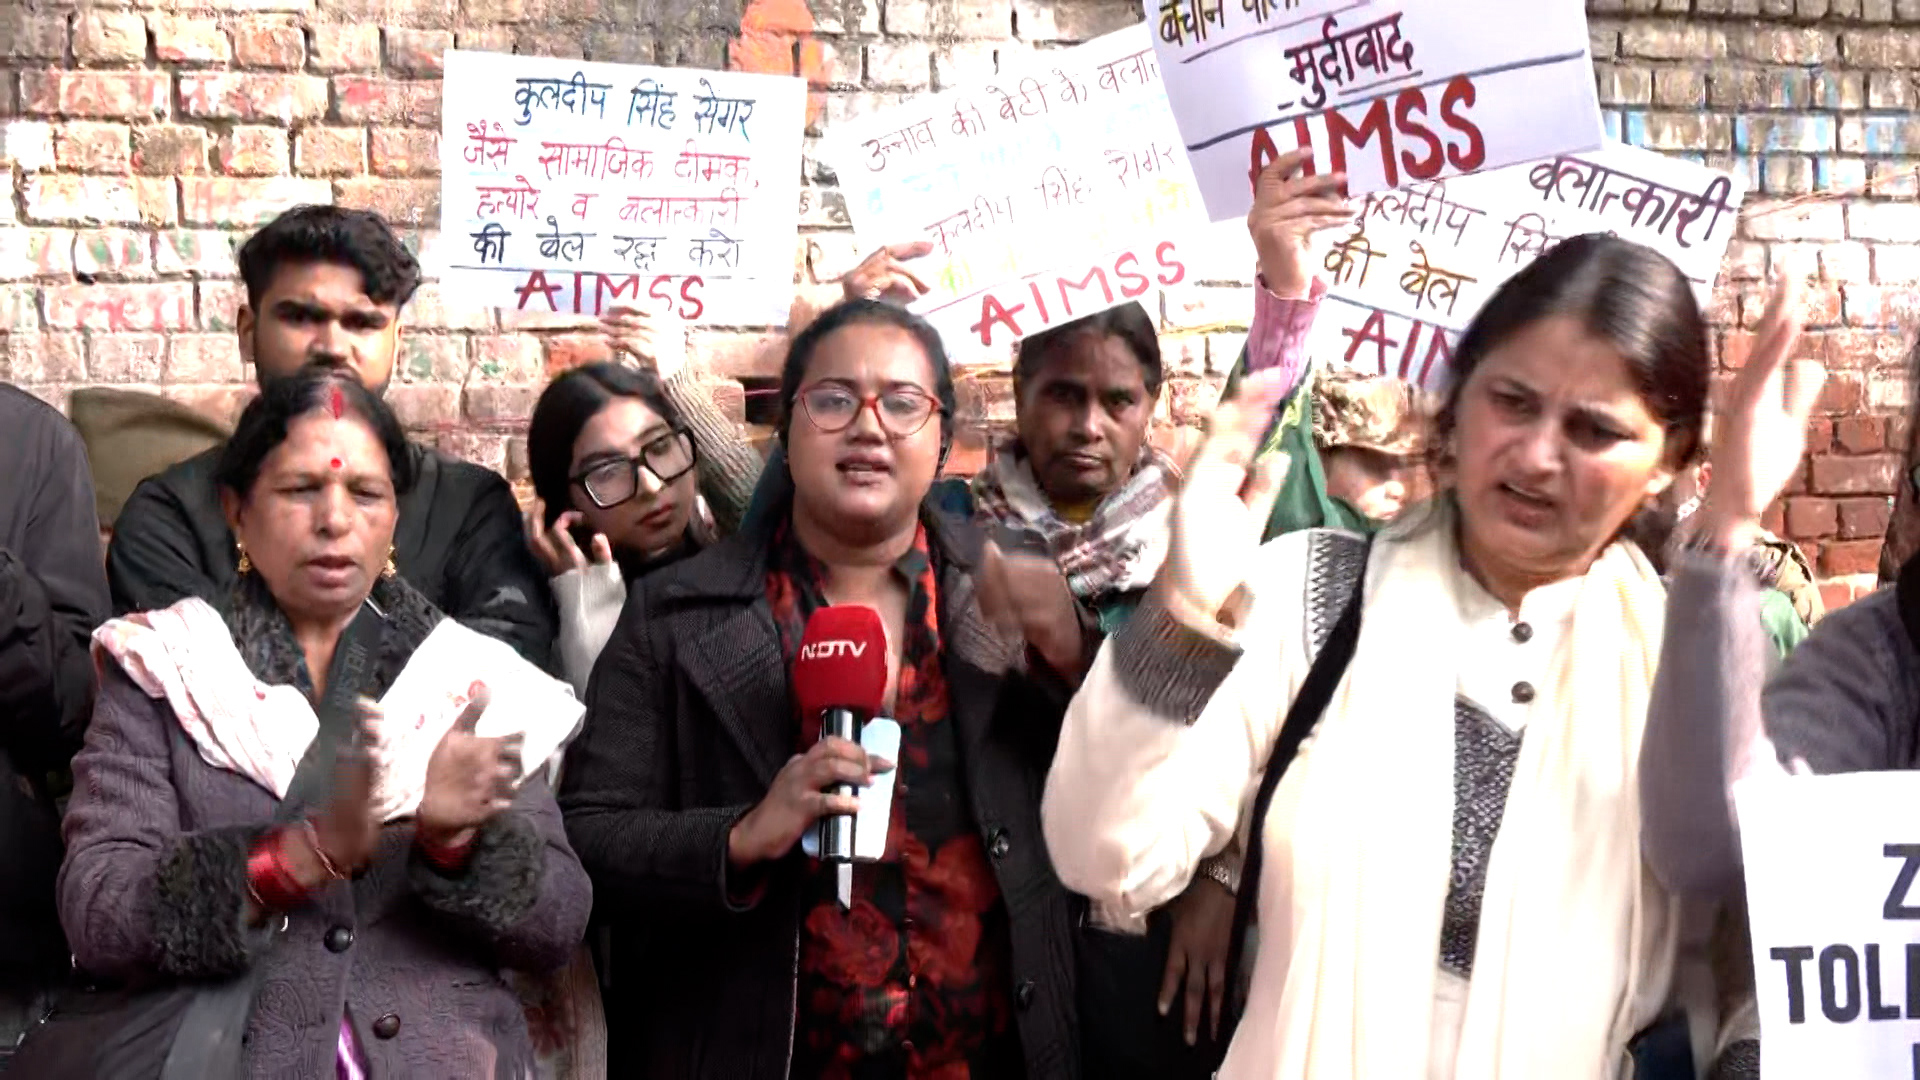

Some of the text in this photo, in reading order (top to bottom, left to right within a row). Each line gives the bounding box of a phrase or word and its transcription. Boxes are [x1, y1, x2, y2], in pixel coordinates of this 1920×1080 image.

[1284, 12, 1414, 109] मुर्दाबाद
[514, 71, 613, 126] कुलदीप
[627, 78, 678, 130] सिंह
[861, 117, 936, 172] उन्नाव
[951, 98, 986, 137] की
[986, 77, 1048, 123] बेटी
[463, 119, 518, 171] जैसे
[538, 136, 654, 181] सामाजिक
[1248, 73, 1486, 200] AIMSS
[571, 193, 600, 221] व
[618, 187, 749, 226] बलात्कारी
[1530, 153, 1737, 248] बलात्कारी
[470, 221, 512, 264] की
[536, 215, 597, 262] बेल
[689, 227, 744, 267] करो
[1498, 213, 1572, 264] सिं
[514, 269, 704, 320] AIMSS
[970, 241, 1186, 346] AIMSS
[1324, 236, 1477, 317] की बेल
[801, 641, 867, 661] NDTV
